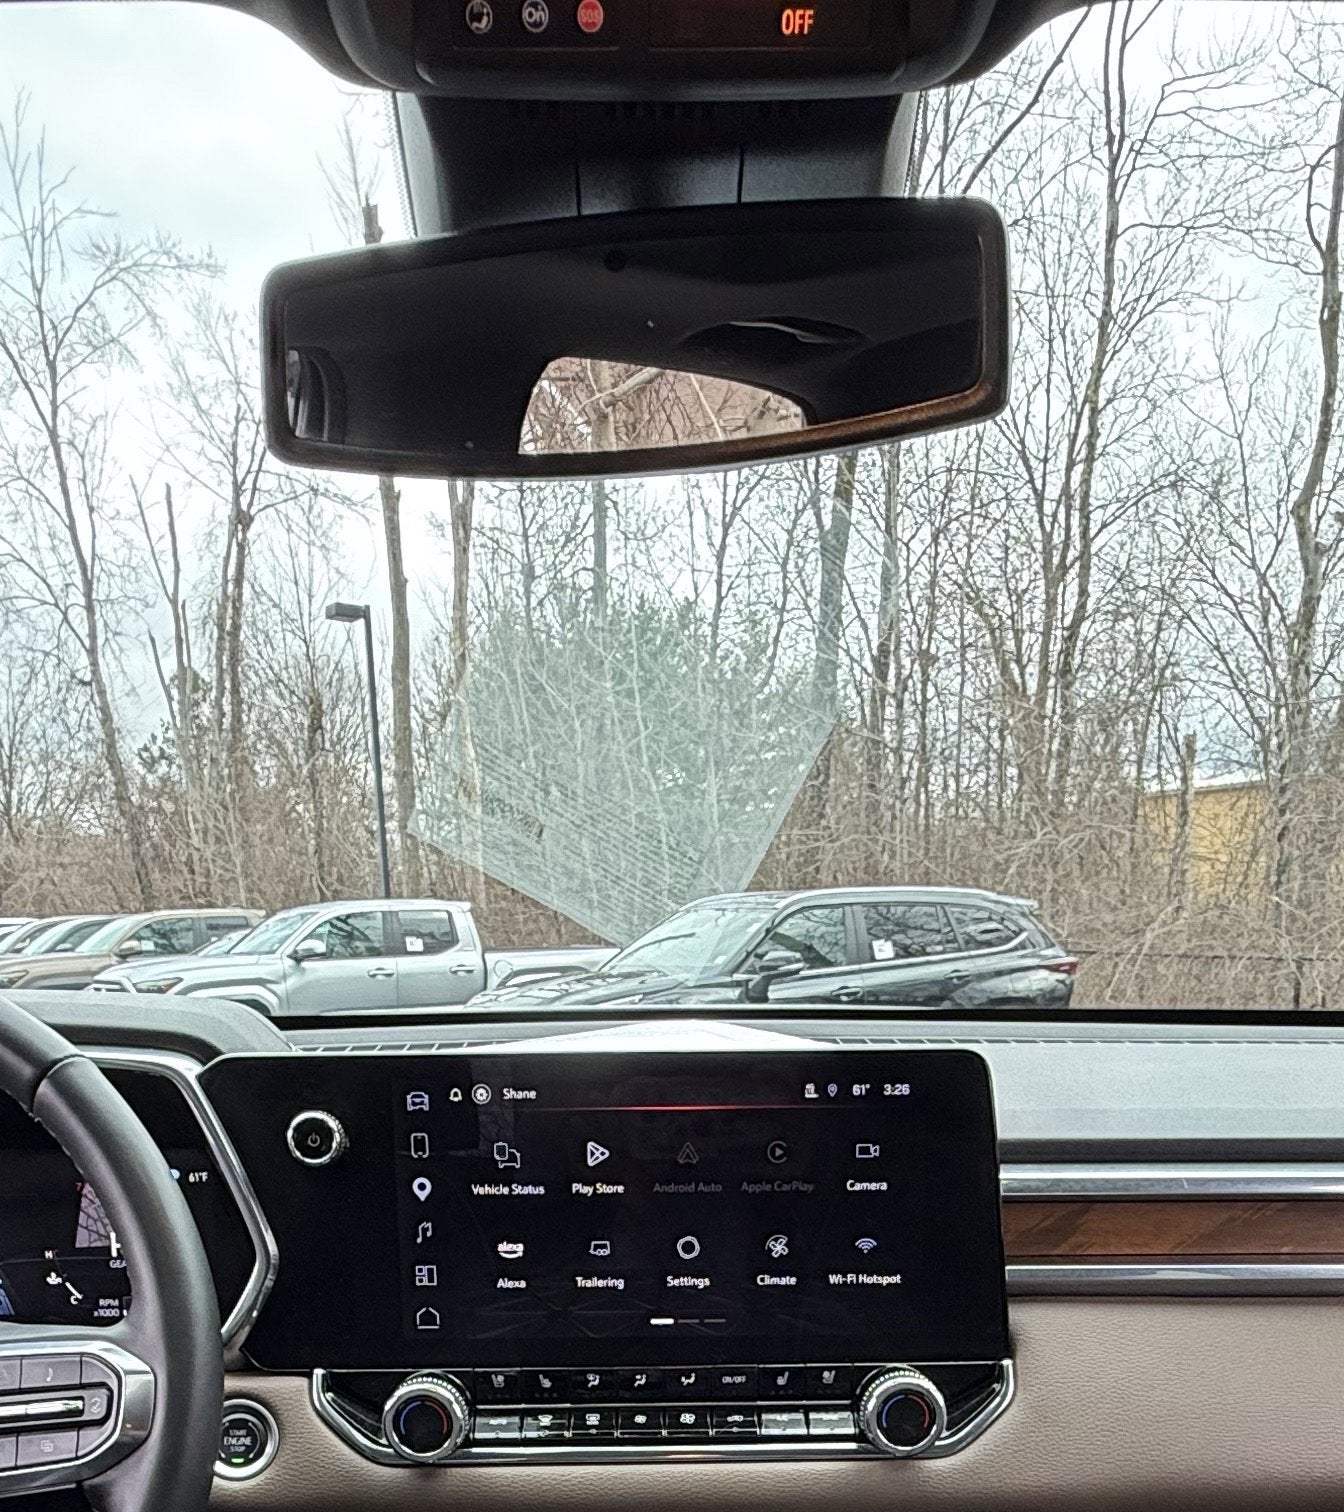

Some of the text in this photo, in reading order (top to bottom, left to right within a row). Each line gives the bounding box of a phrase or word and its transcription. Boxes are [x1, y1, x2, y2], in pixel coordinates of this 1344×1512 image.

[579, 10, 599, 23] SOS
[781, 8, 814, 35] OFF
[502, 1088, 537, 1100] Shane
[883, 1083, 910, 1096] 3:26
[471, 1183, 545, 1196] Vehicle Status
[572, 1182, 625, 1197] Play Store
[653, 1181, 723, 1193] Android Auto
[740, 1180, 815, 1194] Apple CarPlay
[846, 1180, 888, 1192] Camera
[109, 1260, 127, 1269] GEA
[497, 1278, 527, 1289] Alexa
[575, 1276, 625, 1290] Trailering
[666, 1276, 710, 1289] Settings
[756, 1274, 797, 1286] Climate
[828, 1273, 902, 1287] Wi-Fi Hotspot
[98, 1298, 120, 1307] RPM
[722, 1375, 747, 1384] ON/OFF
[229, 1429, 248, 1437] START
[223, 1436, 253, 1446] ENGINE
[229, 1445, 247, 1453] STOP
